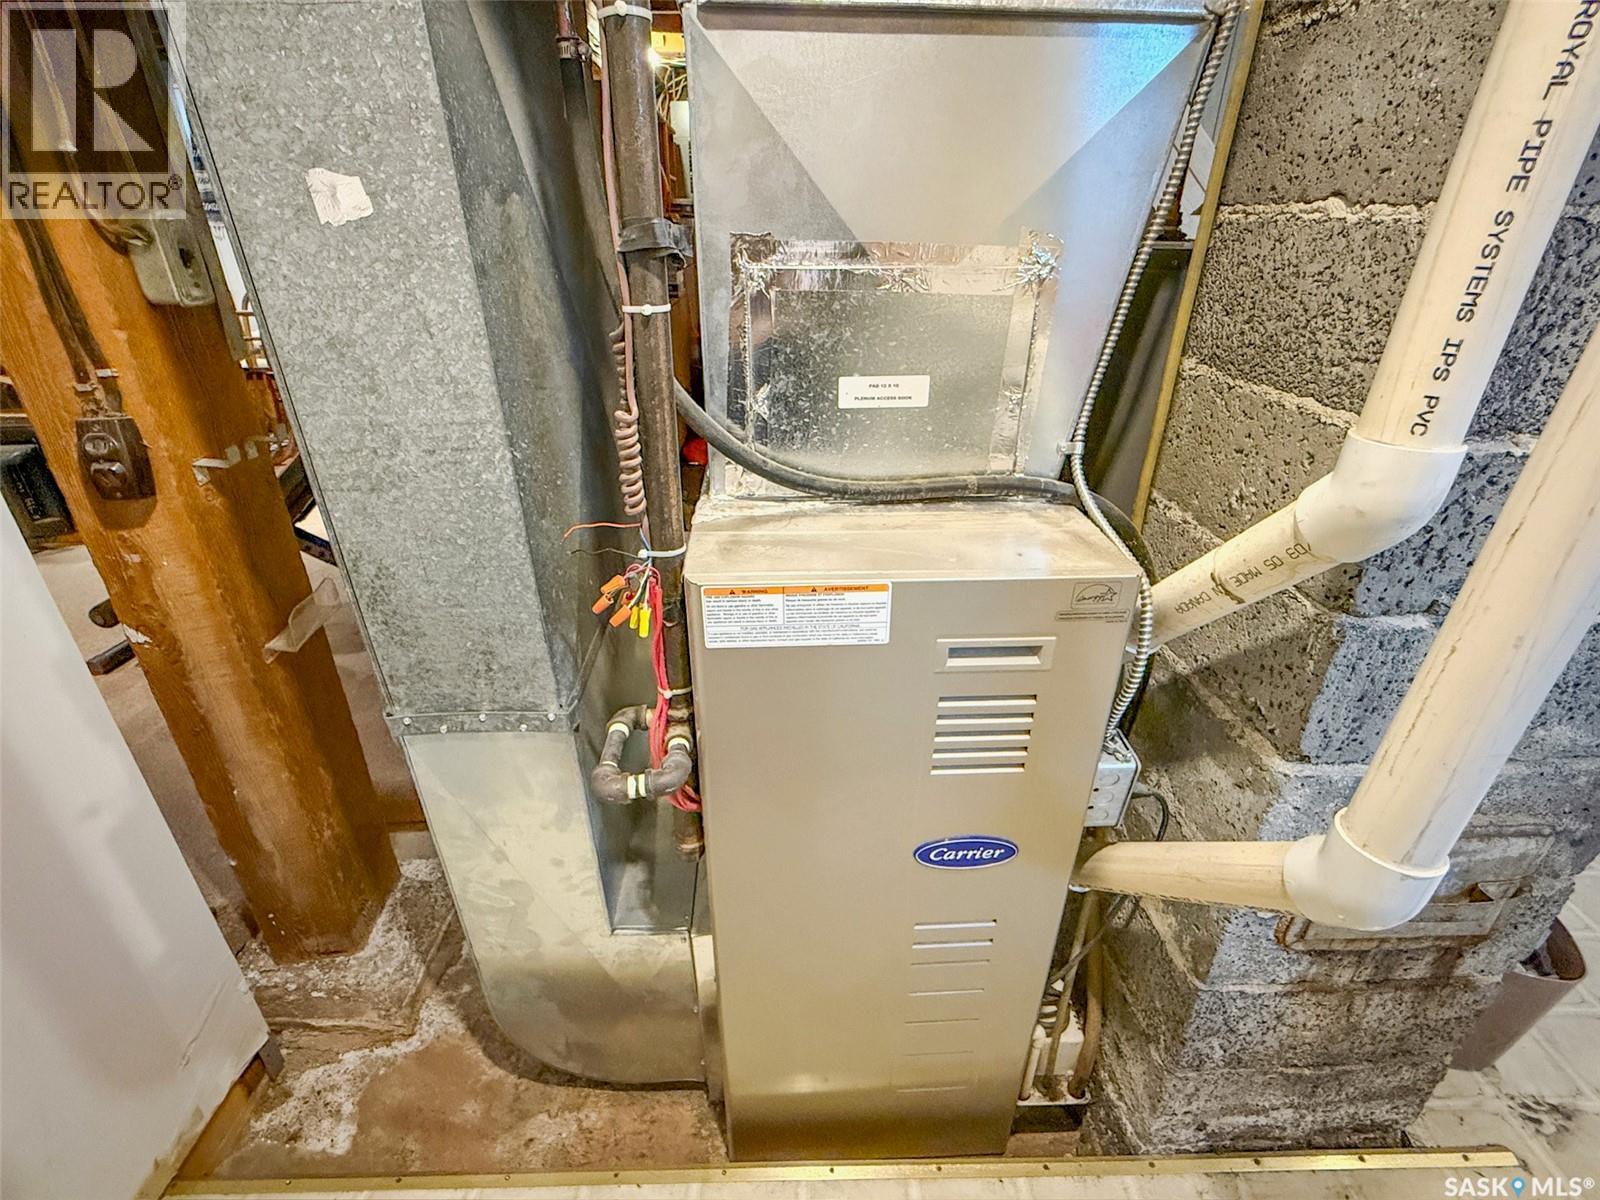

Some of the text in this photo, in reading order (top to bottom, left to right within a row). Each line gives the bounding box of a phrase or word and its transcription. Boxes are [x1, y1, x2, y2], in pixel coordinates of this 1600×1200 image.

[1410, 0, 1600, 437] ROYAL PIPE SYSTEMS IPS PVC
[1229, 566, 1263, 587] MADE
[1174, 591, 1212, 615] CANADA
[929, 846, 1005, 861] Carrier
